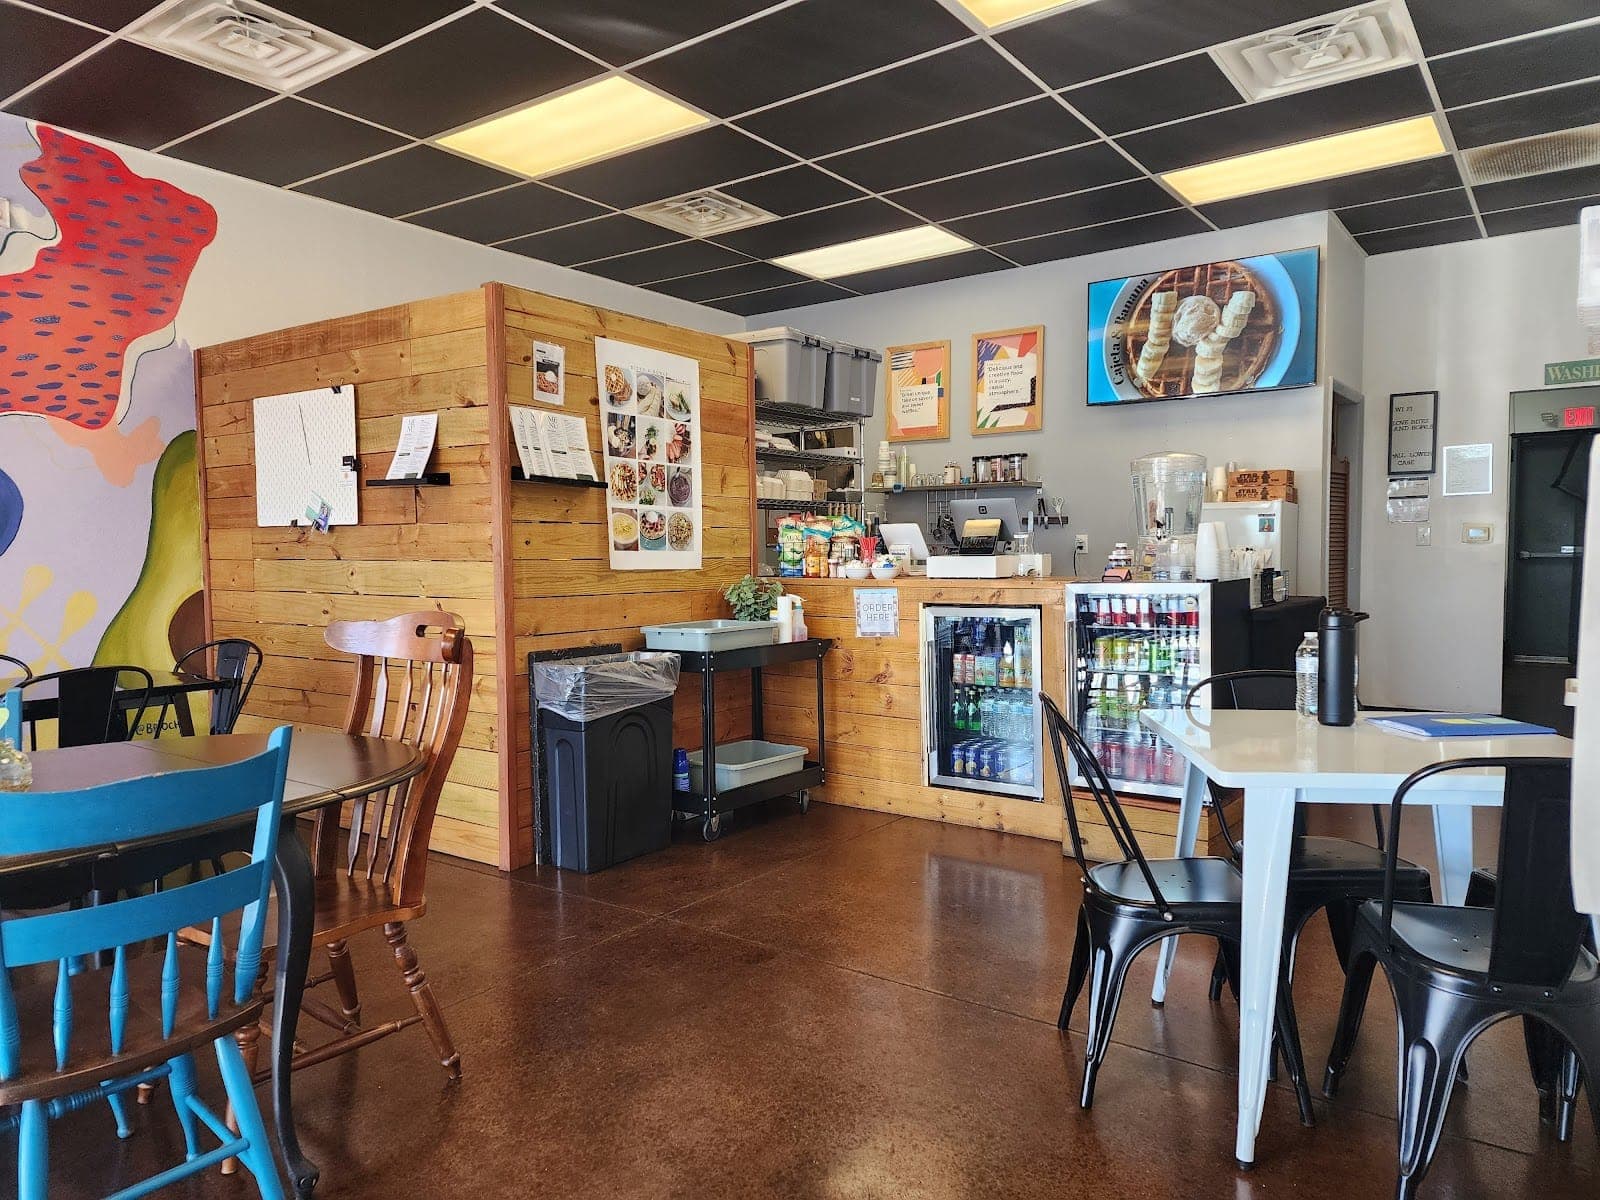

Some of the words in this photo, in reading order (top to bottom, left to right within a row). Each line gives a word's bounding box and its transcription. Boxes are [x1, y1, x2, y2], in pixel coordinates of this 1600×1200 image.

[1114, 278, 1149, 324] Banana
[1111, 331, 1122, 339] &
[1110, 343, 1124, 386] Cajeta
[1567, 408, 1594, 425] EXIT
[862, 603, 893, 612] ORDER
[866, 613, 890, 622] HERE
